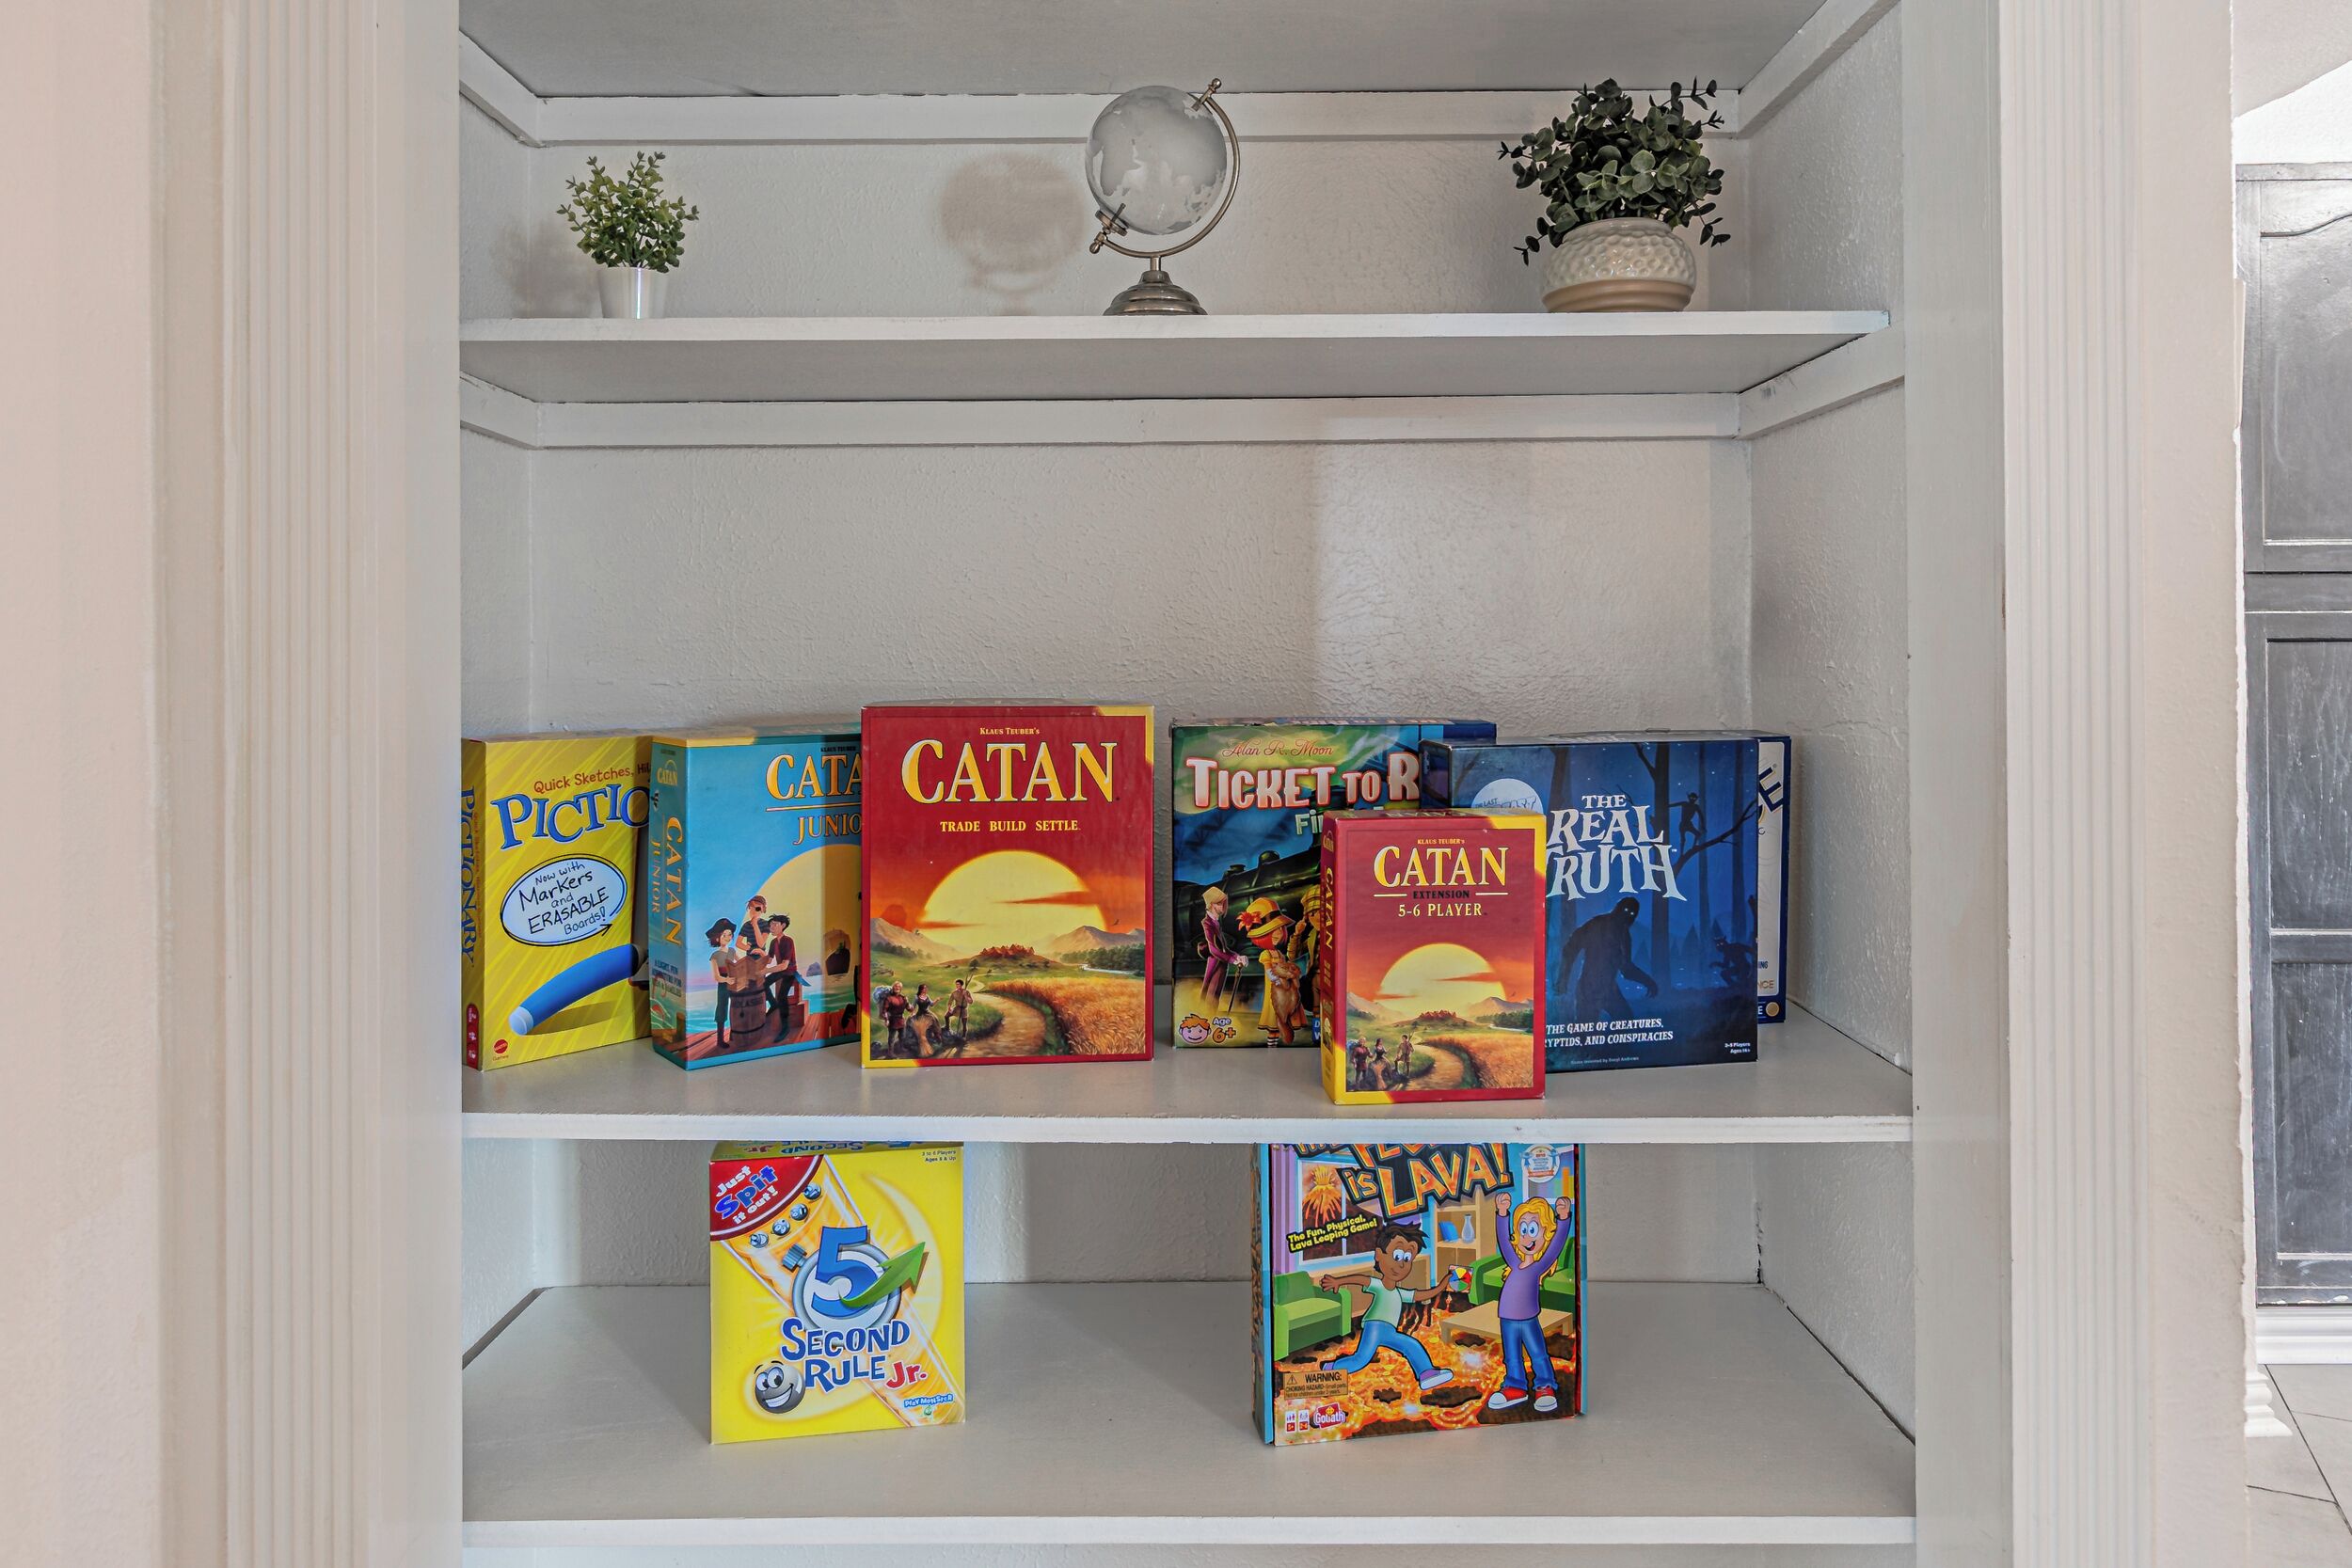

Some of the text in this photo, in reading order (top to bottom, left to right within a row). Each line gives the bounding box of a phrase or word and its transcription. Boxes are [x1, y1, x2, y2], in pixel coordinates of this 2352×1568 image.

[1222, 738, 1333, 757] Alan R. Moon
[534, 776, 570, 794] Quick
[574, 768, 634, 786] Sketches,
[901, 739, 1118, 804] CATAN
[1185, 757, 1336, 810] TICKET
[1342, 769, 1382, 804] TO
[1581, 795, 1627, 809] THE
[940, 820, 1079, 832] TRADE BUILD SETTLE
[1546, 805, 1664, 852] REAL
[535, 861, 585, 885] Now with
[651, 840, 660, 913] JUNIOR
[666, 816, 683, 946] CATAN
[1374, 846, 1509, 888] CATAN
[519, 871, 593, 911] Markers
[551, 893, 574, 908] and
[1413, 890, 1470, 900] EXTENSION
[528, 887, 609, 934] ERASABLE
[564, 906, 606, 935] Boards!
[1326, 867, 1334, 950] CATAN
[1398, 903, 1482, 917] 5-6 PLAYER
[1212, 1017, 1232, 1026] Age
[1212, 1027, 1236, 1043] 6+
[1546, 1024, 1565, 1035] THE
[1567, 1022, 1594, 1034] GAME
[1597, 1022, 1608, 1031] OF
[1584, 1035, 1605, 1046] AND
[1608, 1031, 1674, 1044] CONSPIRACIES
[716, 1165, 751, 1196] Just
[1377, 1143, 1510, 1216] LAVA!
[733, 1185, 778, 1224] it out!
[1288, 1234, 1305, 1243] The
[1290, 1218, 1377, 1251] Lava Leaping Game!
[811, 1226, 880, 1318] 5
[781, 1317, 911, 1361] SECOND
[804, 1355, 928, 1393] RULE Jr.
[1305, 1371, 1343, 1384] WARNING:
